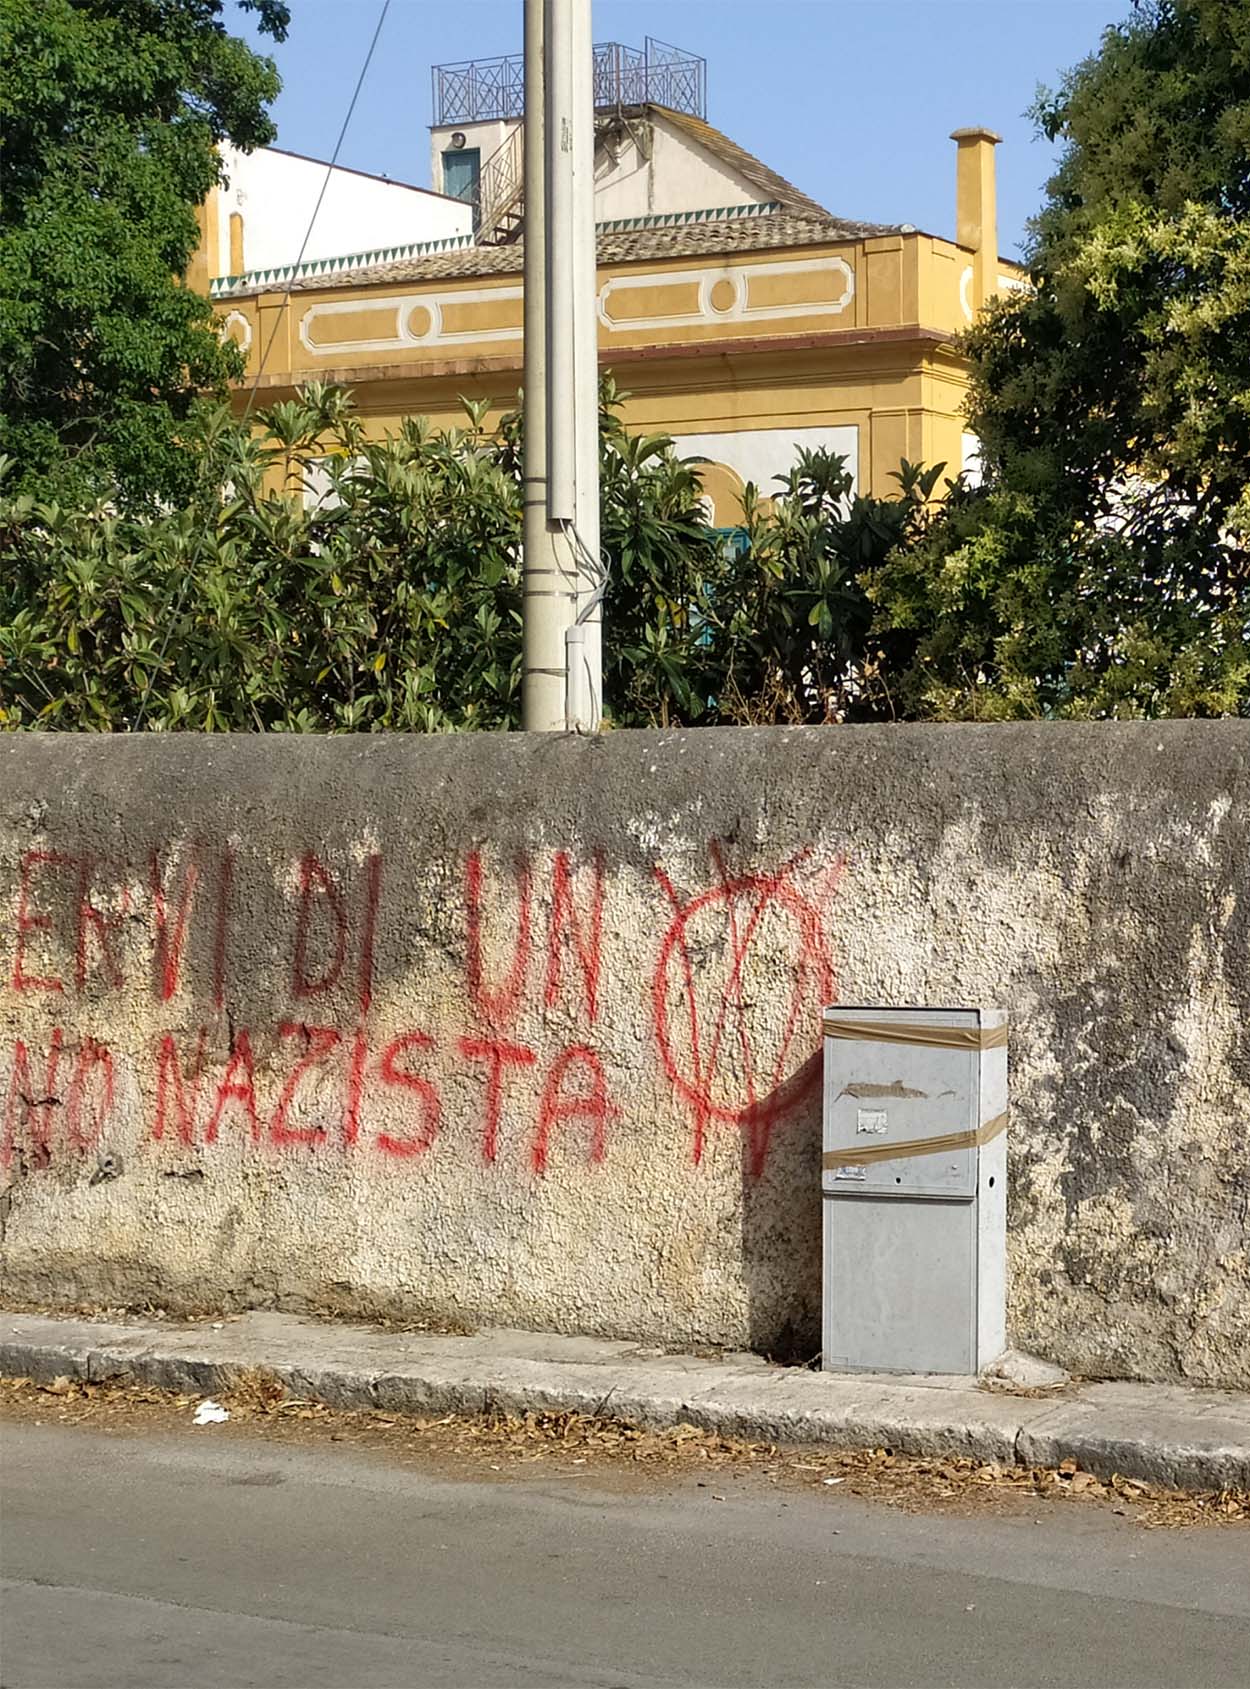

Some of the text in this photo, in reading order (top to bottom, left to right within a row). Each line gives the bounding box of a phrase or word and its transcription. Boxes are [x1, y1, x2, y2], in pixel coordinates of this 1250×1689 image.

[295, 849, 385, 1018] DI
[465, 848, 607, 1030] UN
[152, 1020, 622, 1174] NAZISTA
